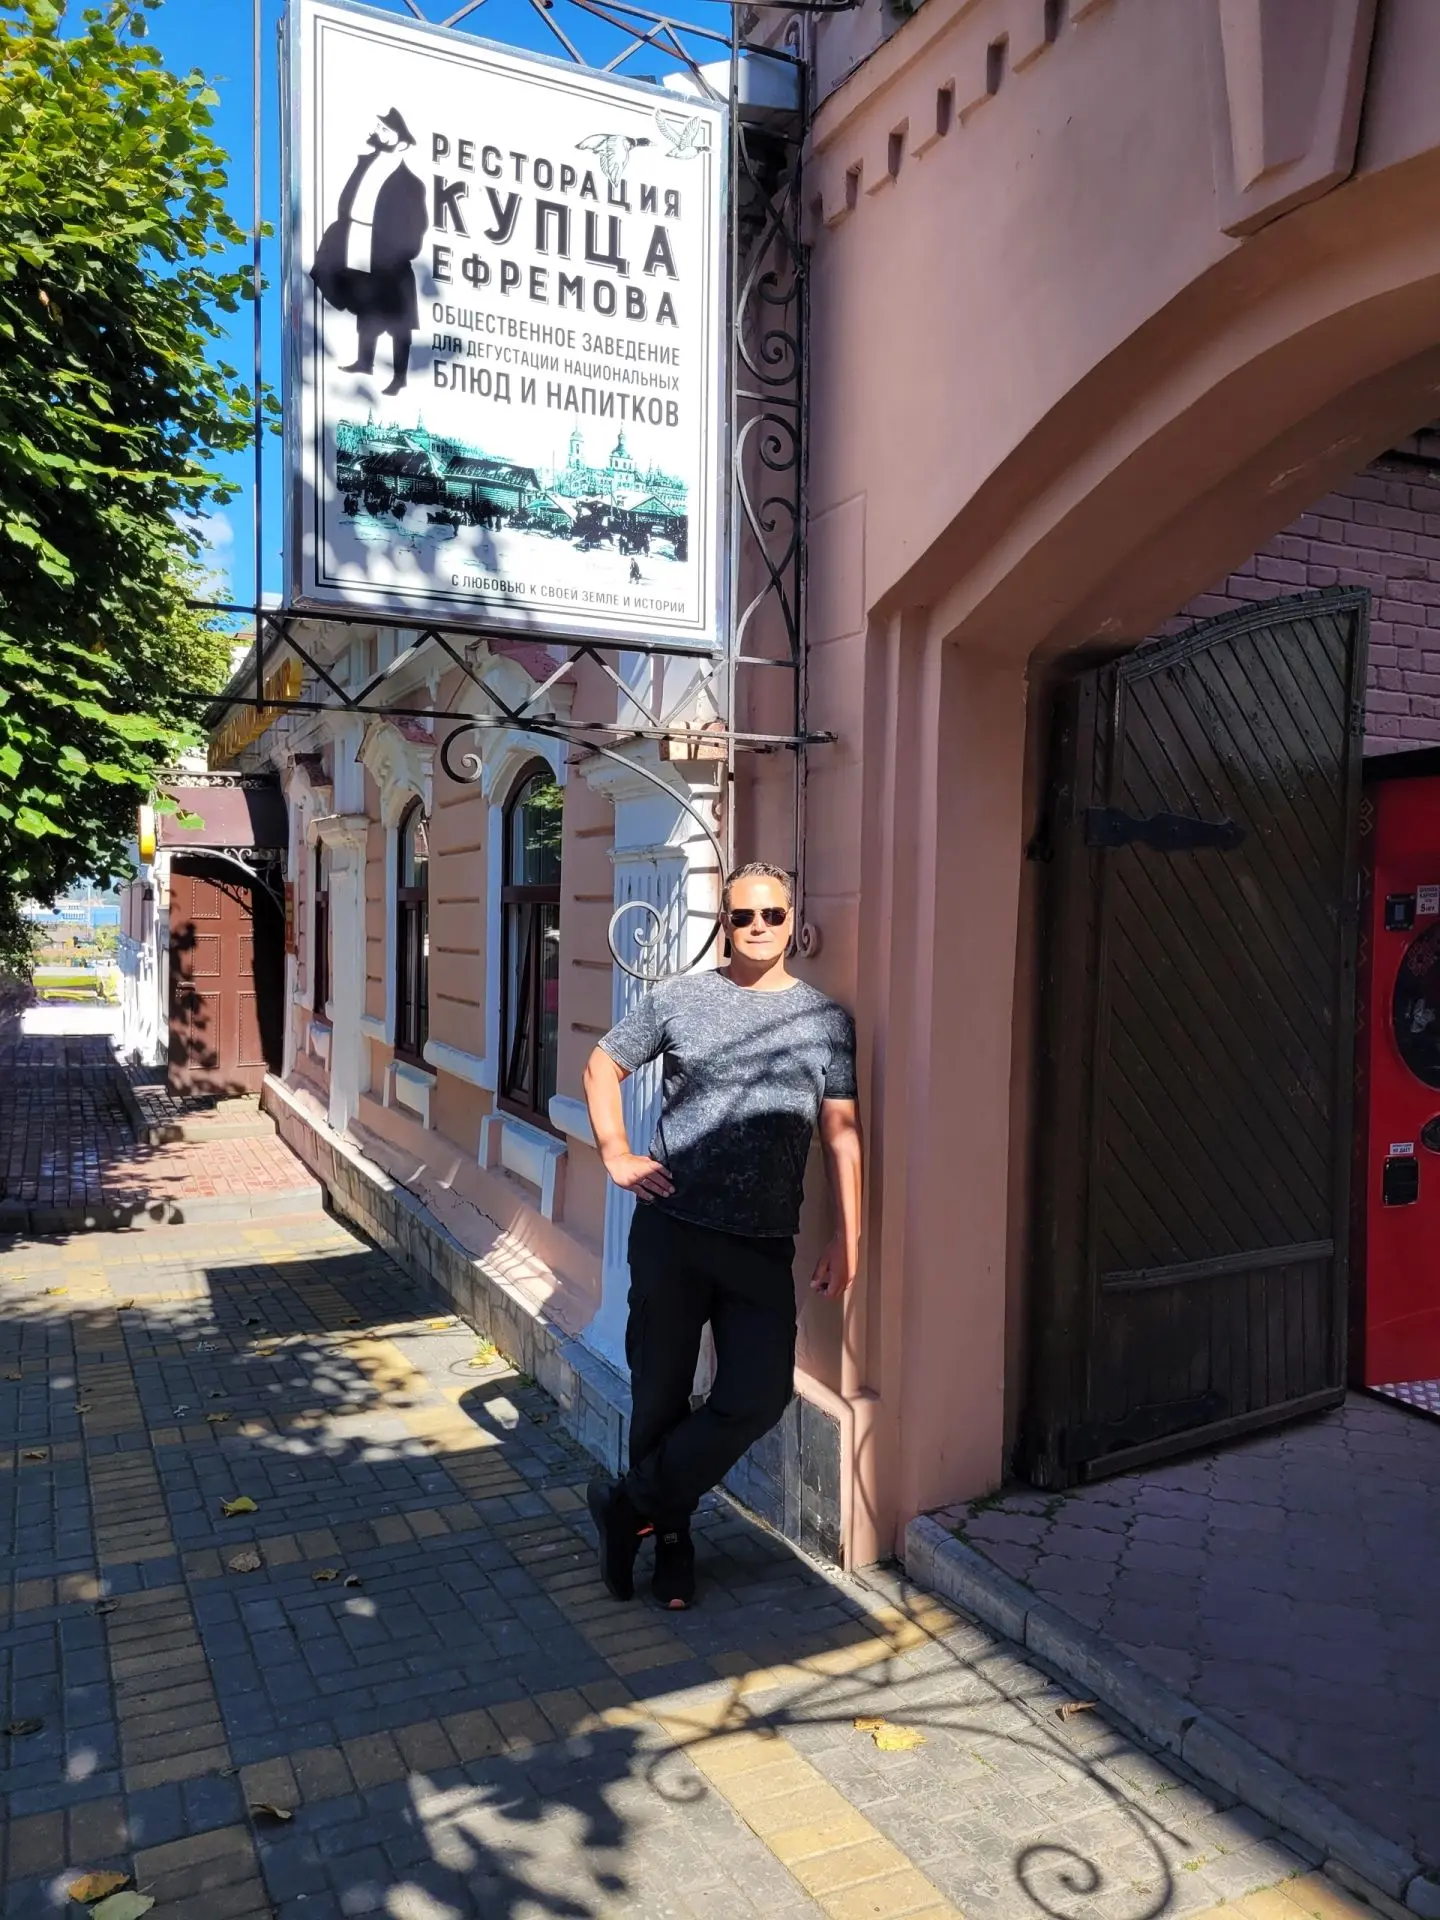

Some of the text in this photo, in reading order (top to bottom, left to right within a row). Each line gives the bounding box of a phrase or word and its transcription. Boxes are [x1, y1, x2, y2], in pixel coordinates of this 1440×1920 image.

[432, 132, 681, 219] РЕСТОРАЦИЯ
[432, 173, 680, 281] КУПЦА
[432, 243, 679, 328] ЕФРЕМОВА
[432, 302, 681, 367] ОБЩЕСТВЕННОЕ ЗАВЕДЕНИЕ
[432, 332, 680, 392] ДЛЯ ДЕГУСТАЦИИ НАЦИОНАЛЬНЫХ
[433, 359, 680, 428] БЛЮД И НАПИТКОВ
[451, 574, 686, 614] С ЛЮБОВЬЮ К СВОЕЙ ЗЕМЛЕ И ИСТОРИИ
